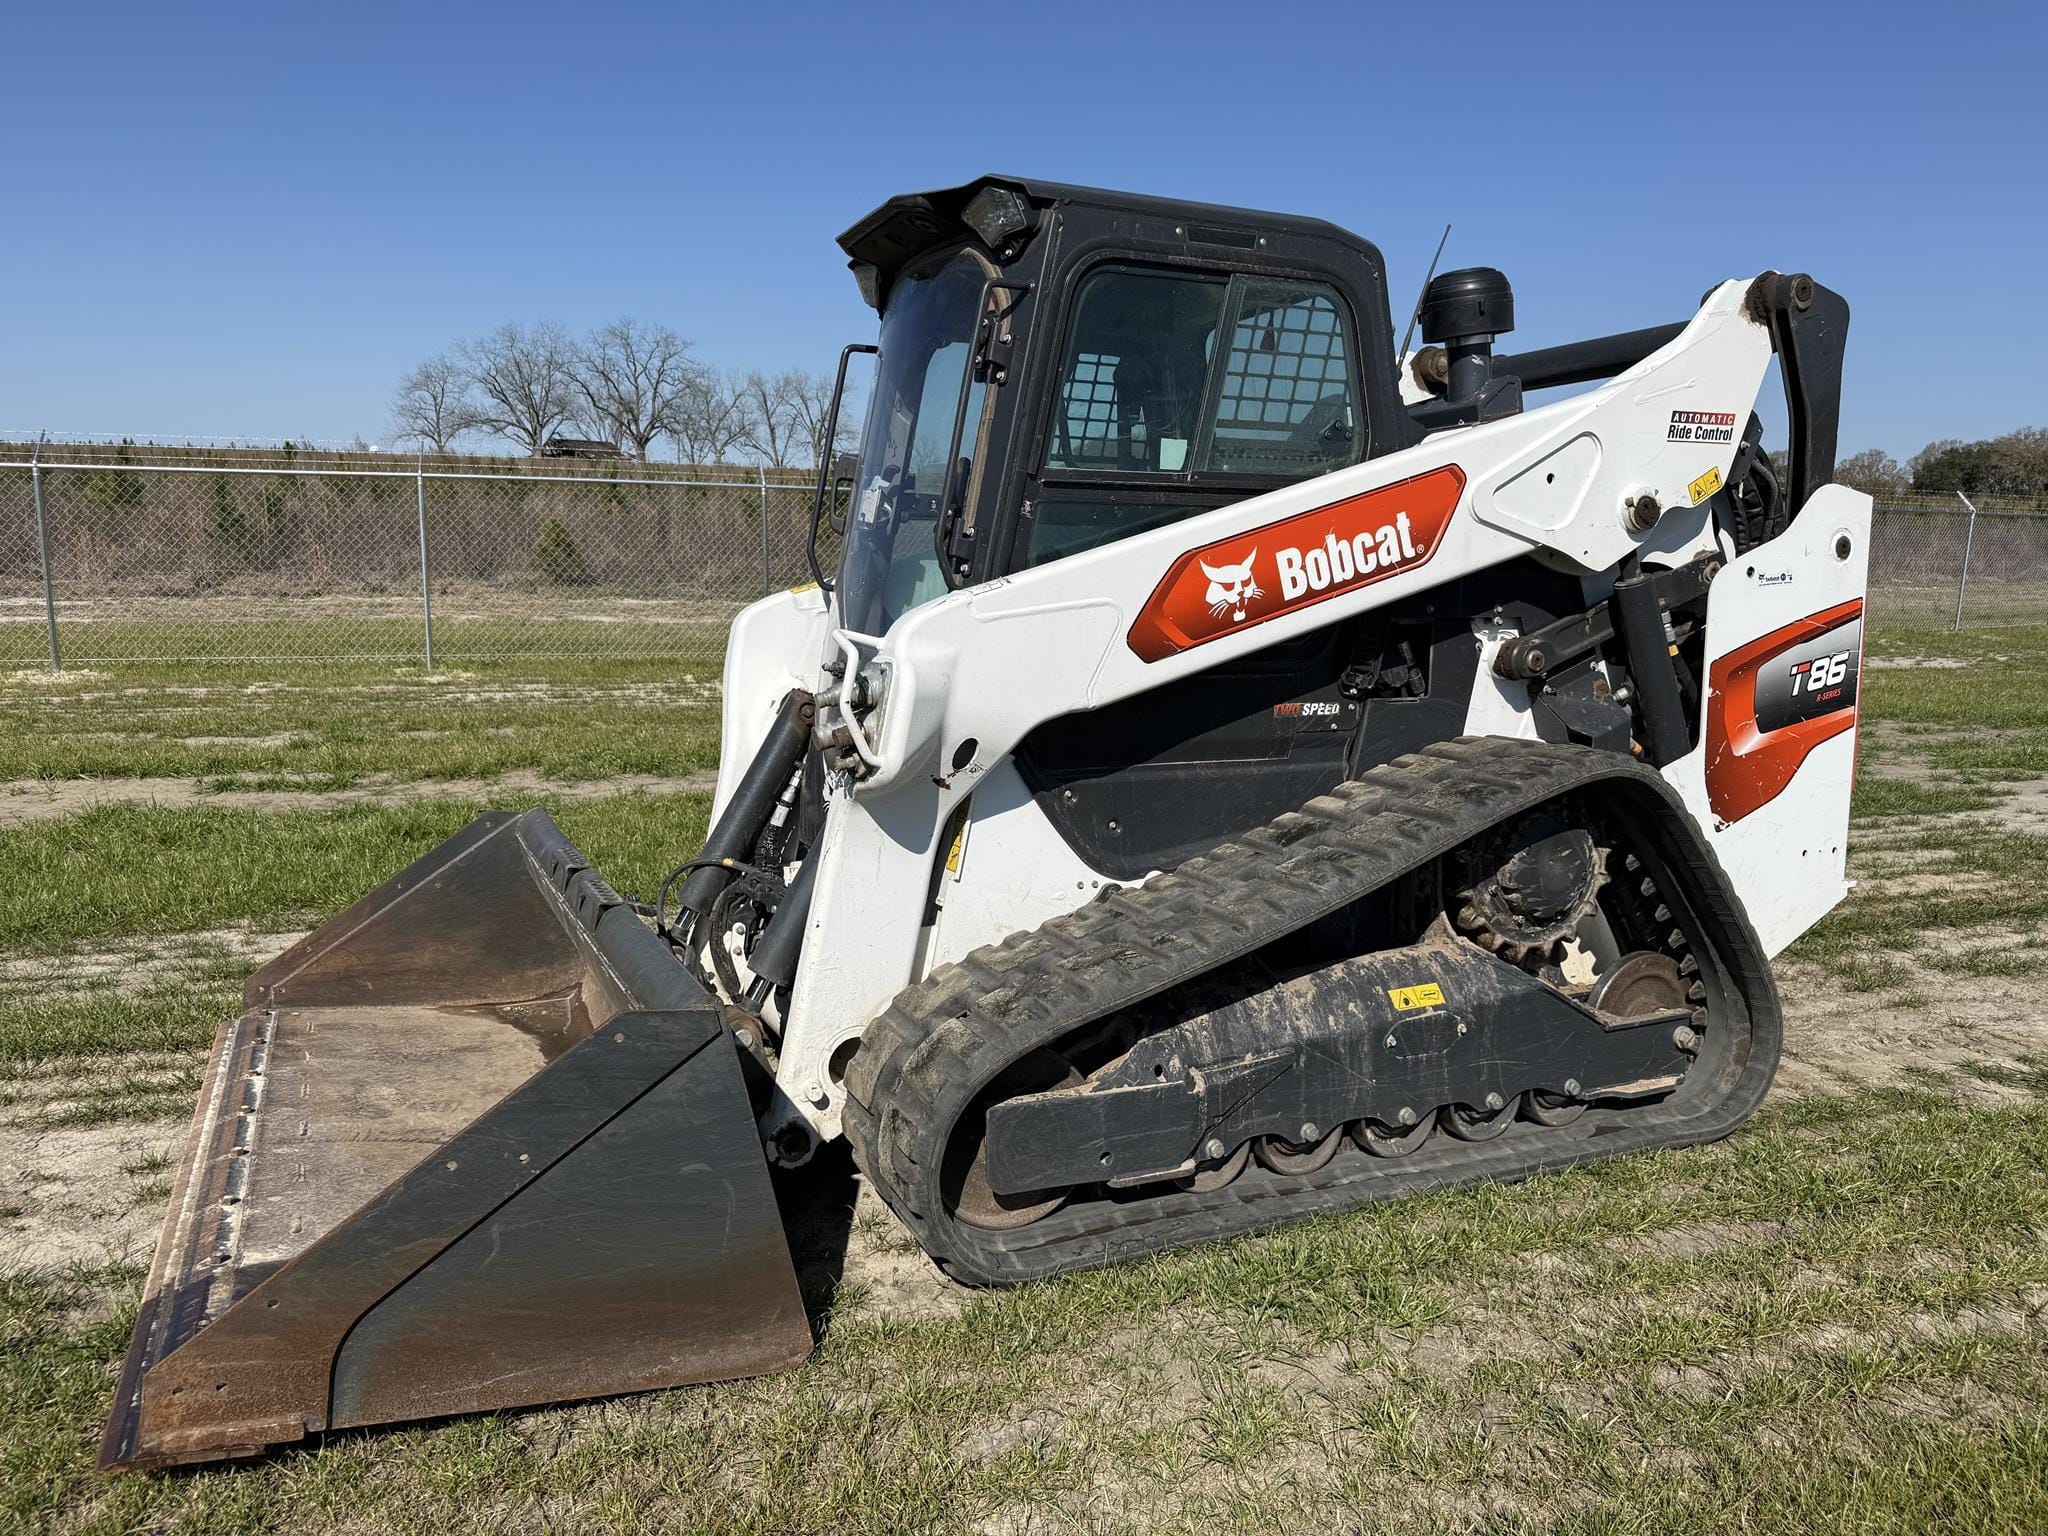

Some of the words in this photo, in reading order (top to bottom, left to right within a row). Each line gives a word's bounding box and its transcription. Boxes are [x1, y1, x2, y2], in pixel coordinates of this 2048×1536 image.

[1672, 412, 1734, 425] AUTOMATIC
[1667, 425, 1692, 439] Ride
[1694, 426, 1734, 441] Control
[1275, 511, 1416, 601] Bobcat
[1790, 651, 1850, 697] T86
[1816, 687, 1842, 702] R-SERIES
[1302, 702, 1340, 716] SPEED
